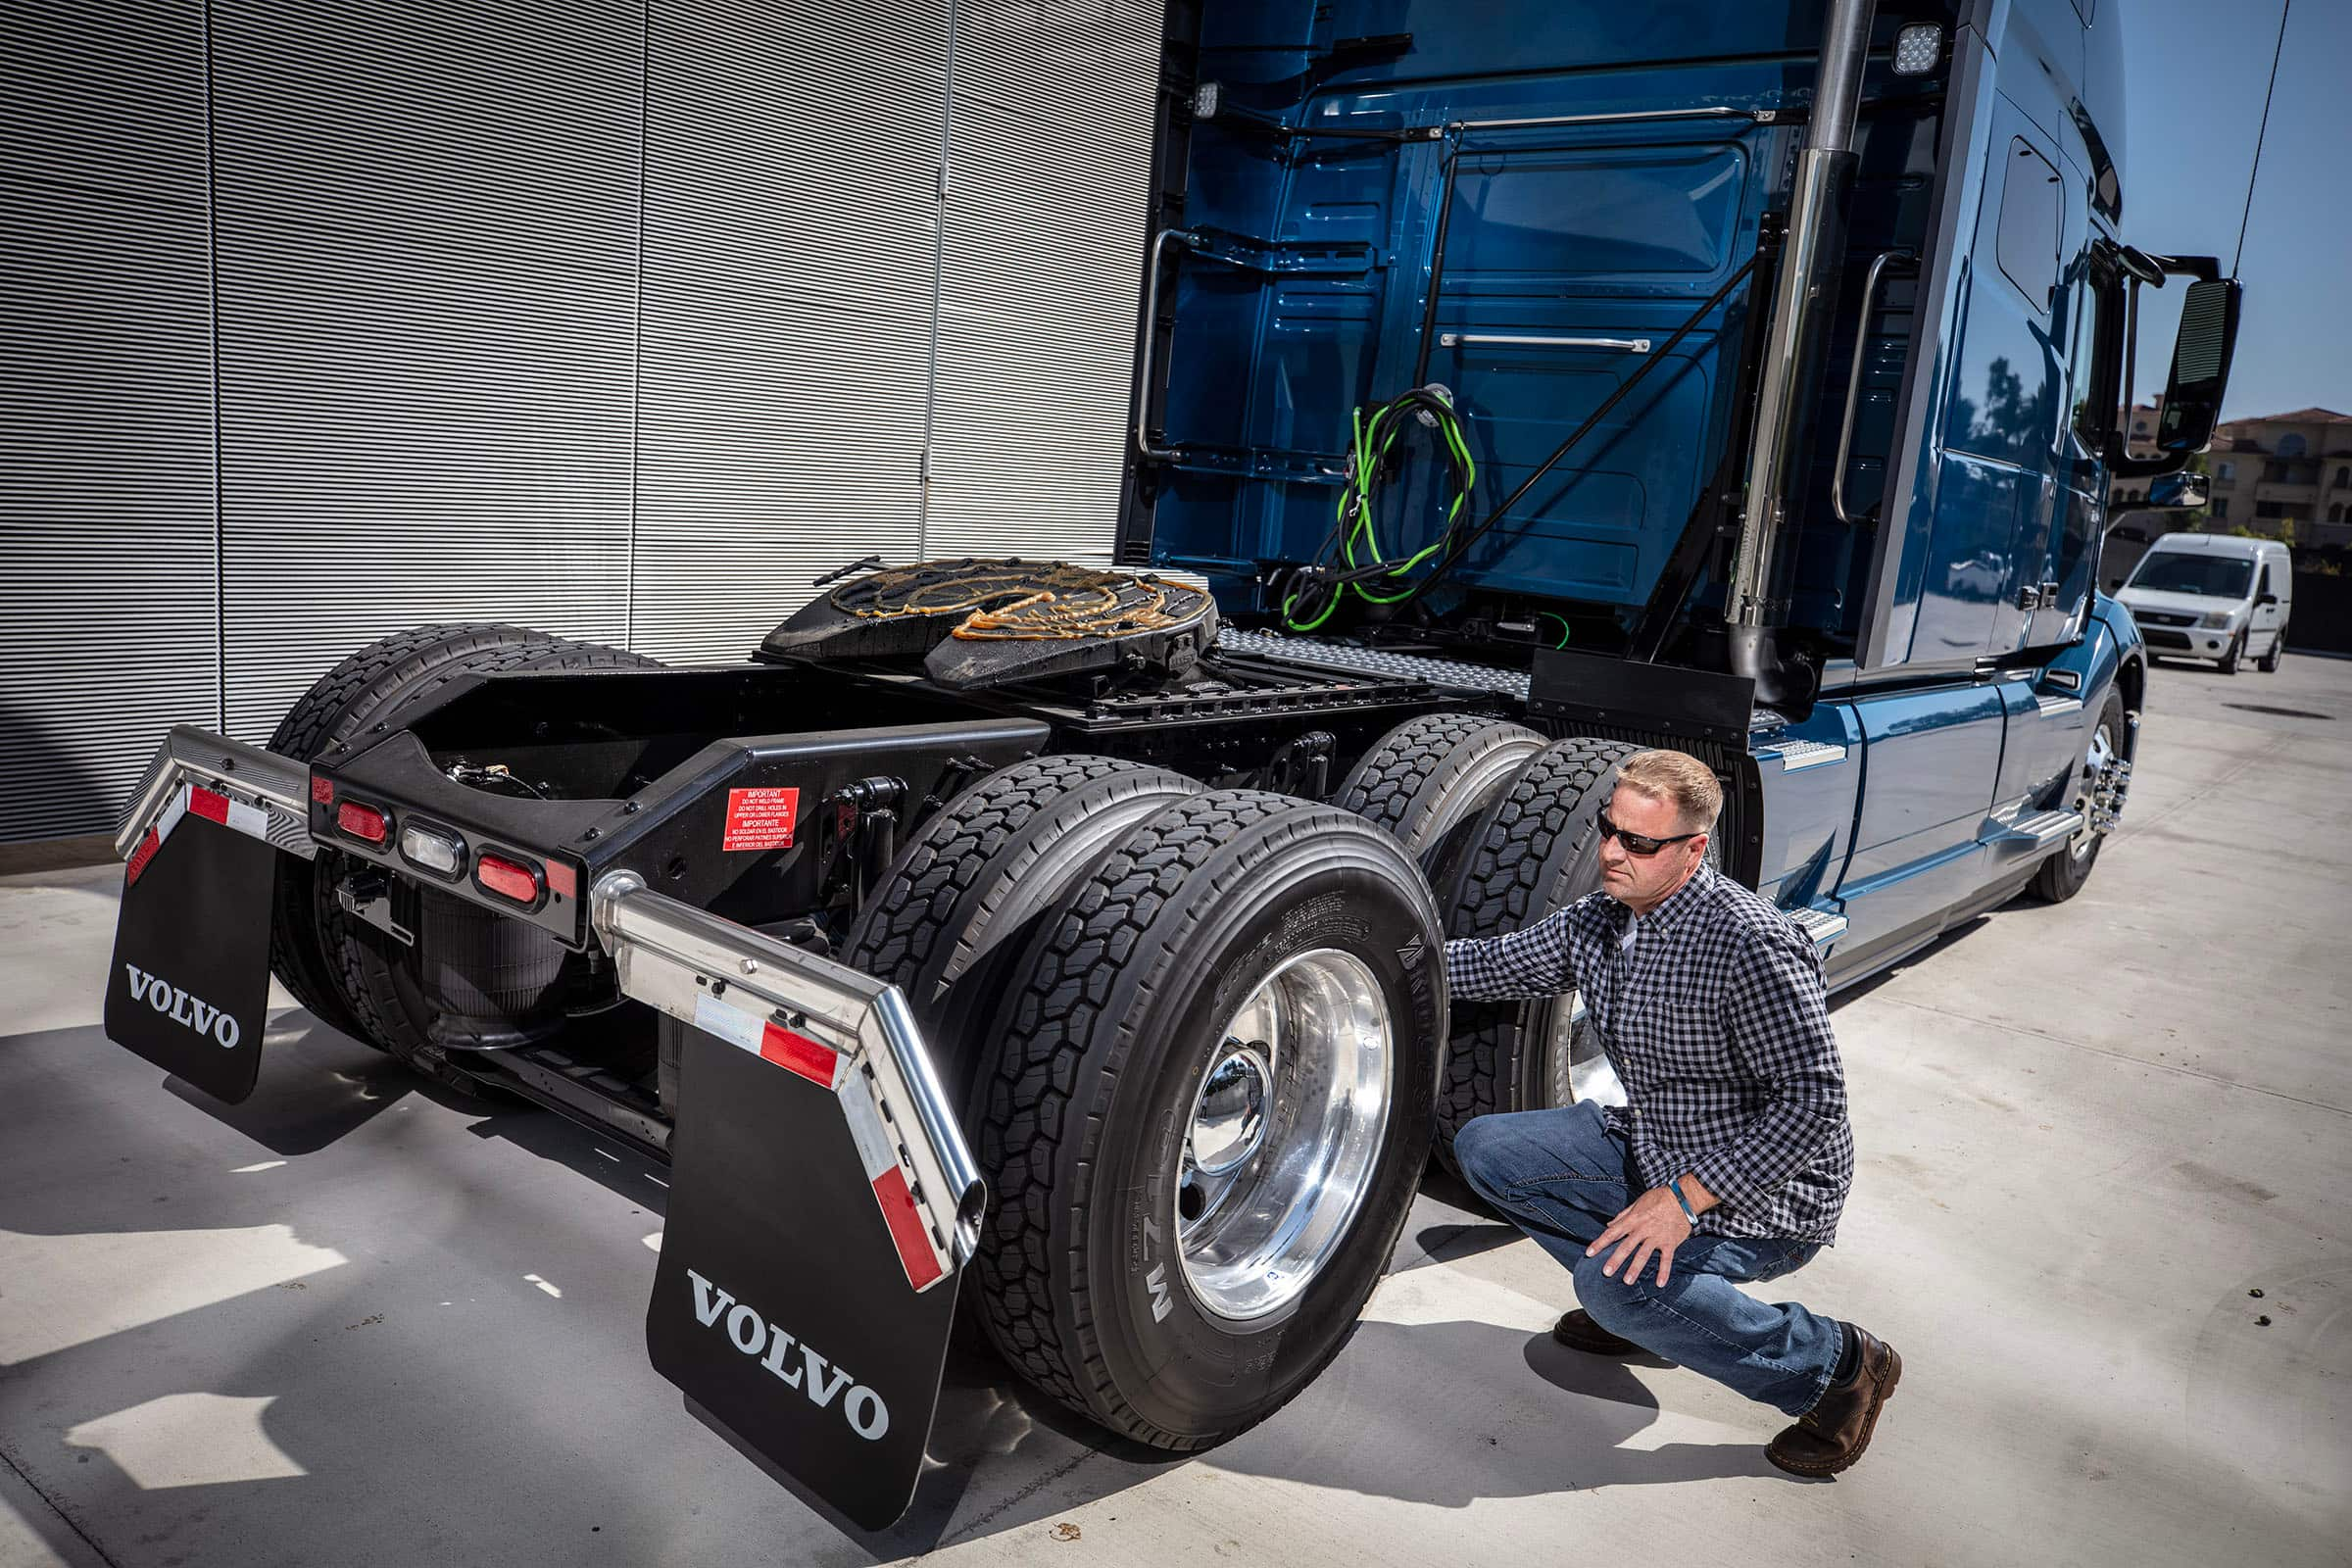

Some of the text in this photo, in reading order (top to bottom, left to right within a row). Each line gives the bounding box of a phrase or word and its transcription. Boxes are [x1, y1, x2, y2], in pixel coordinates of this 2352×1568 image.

[742, 819, 779, 827] IMPORTANTE
[125, 963, 240, 1049] VOLVO
[687, 1268, 890, 1441] VOLVO
